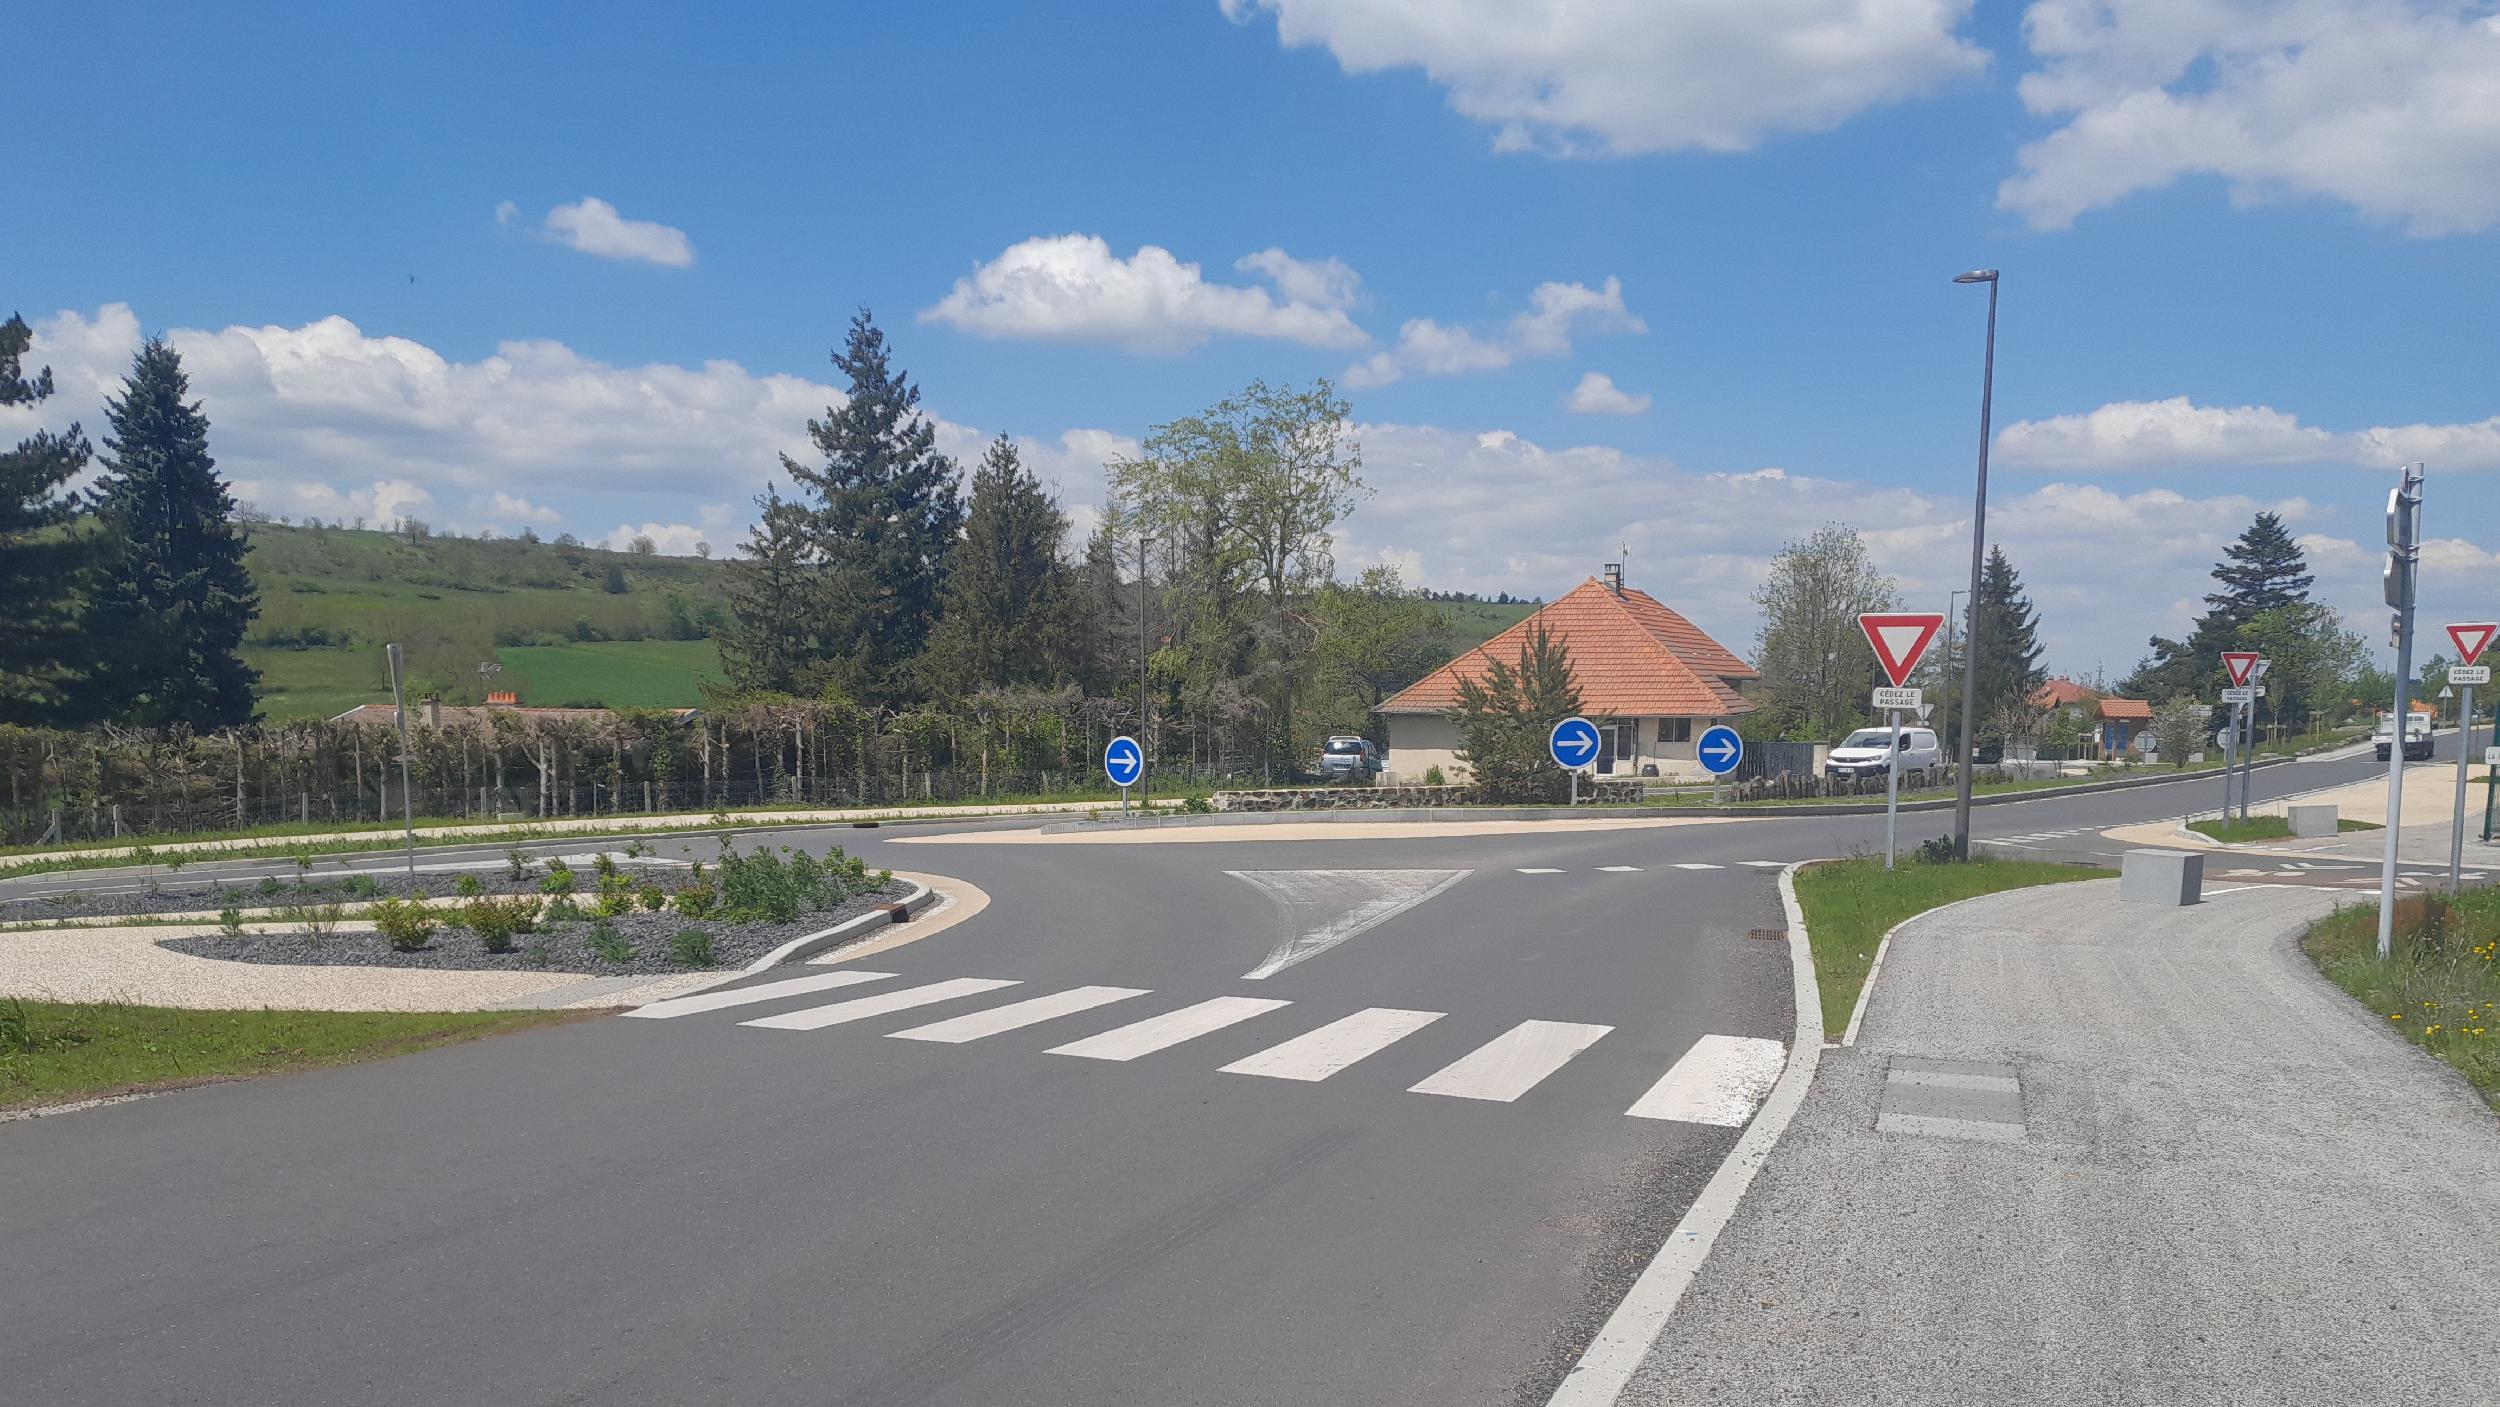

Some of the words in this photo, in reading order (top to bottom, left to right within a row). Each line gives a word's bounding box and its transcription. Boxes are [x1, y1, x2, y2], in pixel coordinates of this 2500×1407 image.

[1880, 690, 1904, 698] CÉDEZ
[1906, 690, 1915, 698] LE
[1880, 698, 1915, 706] PASSAGE
